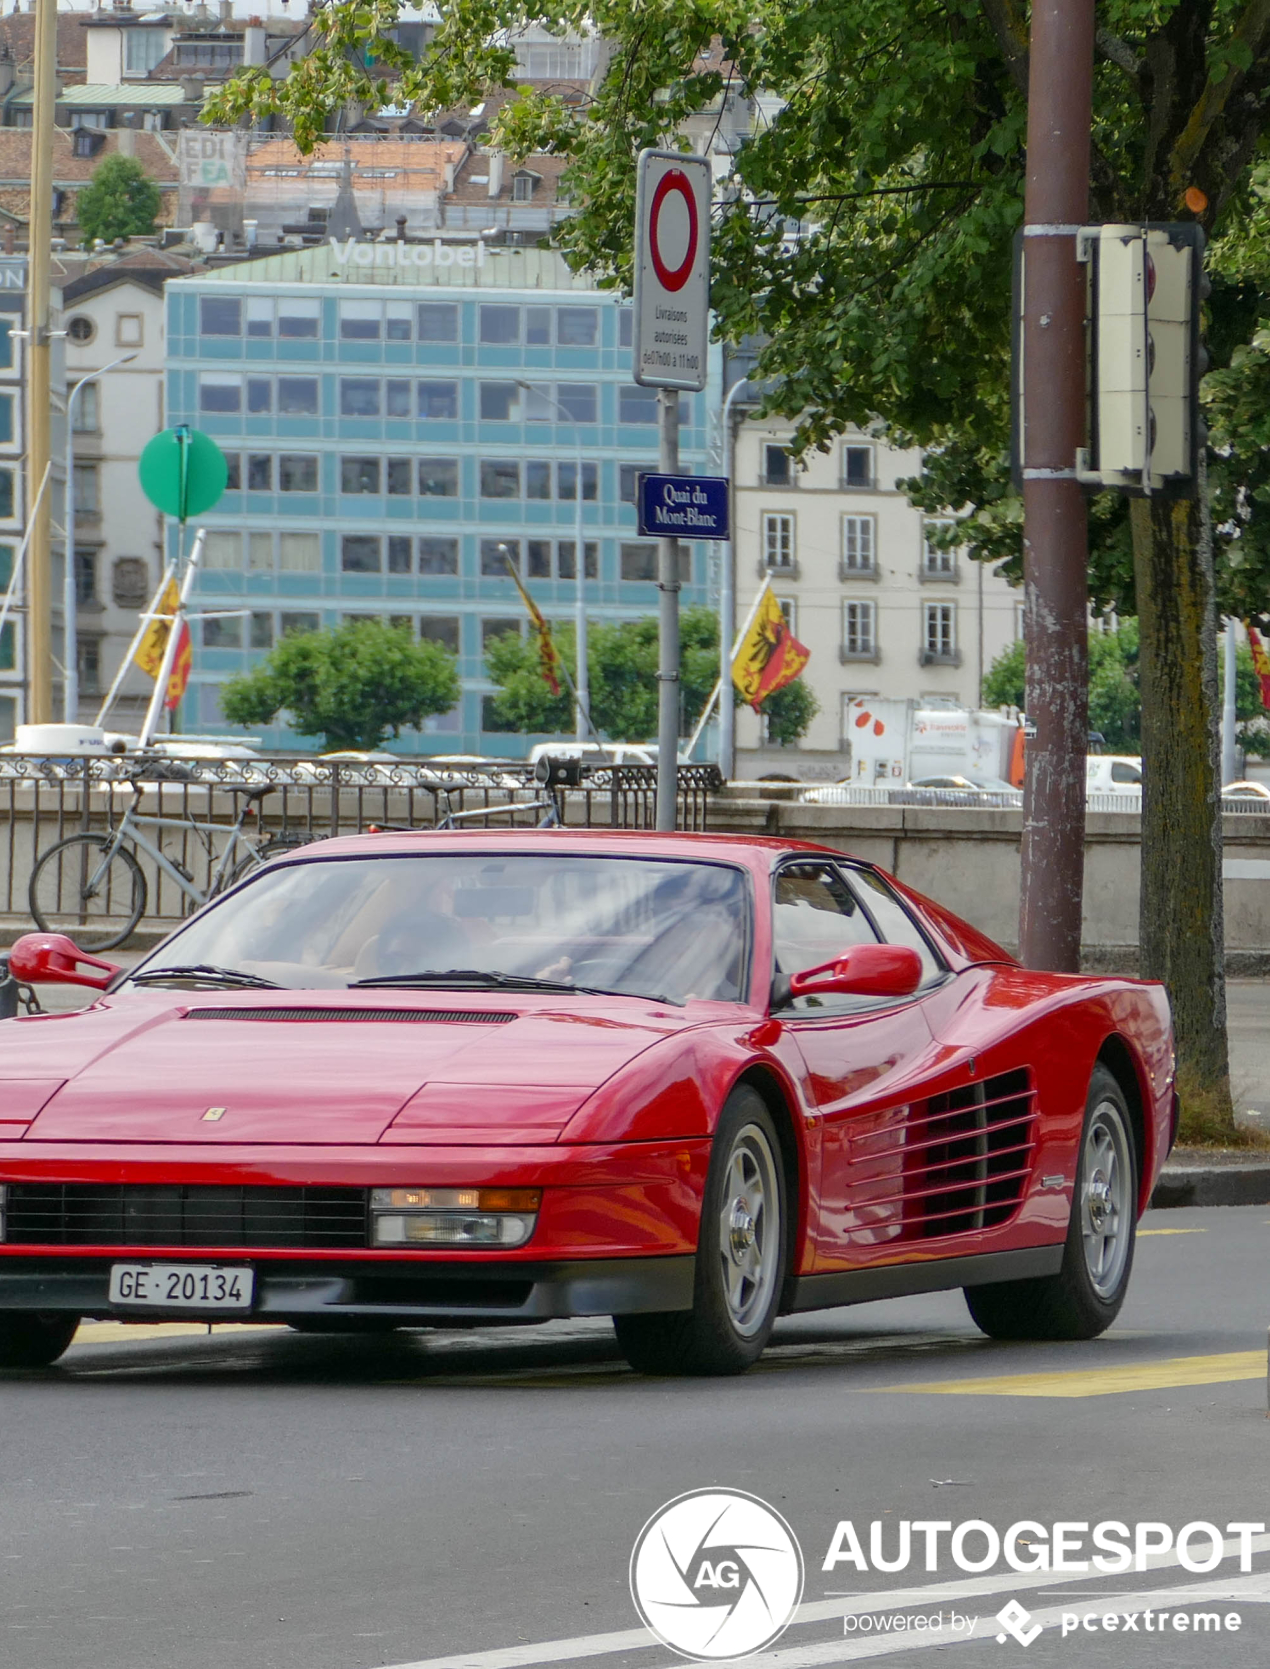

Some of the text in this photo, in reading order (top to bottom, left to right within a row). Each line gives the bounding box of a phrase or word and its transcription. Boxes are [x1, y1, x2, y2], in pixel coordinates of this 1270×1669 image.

[184, 136, 226, 160] EDI
[185, 160, 229, 184] FEA
[329, 237, 485, 267] Vontobel
[655, 304, 688, 323] Livraisons
[654, 330, 688, 346] autorisées
[663, 484, 708, 506] Quai du
[655, 506, 717, 527] Mont-Blanc
[119, 1271, 242, 1302] GE 20134
